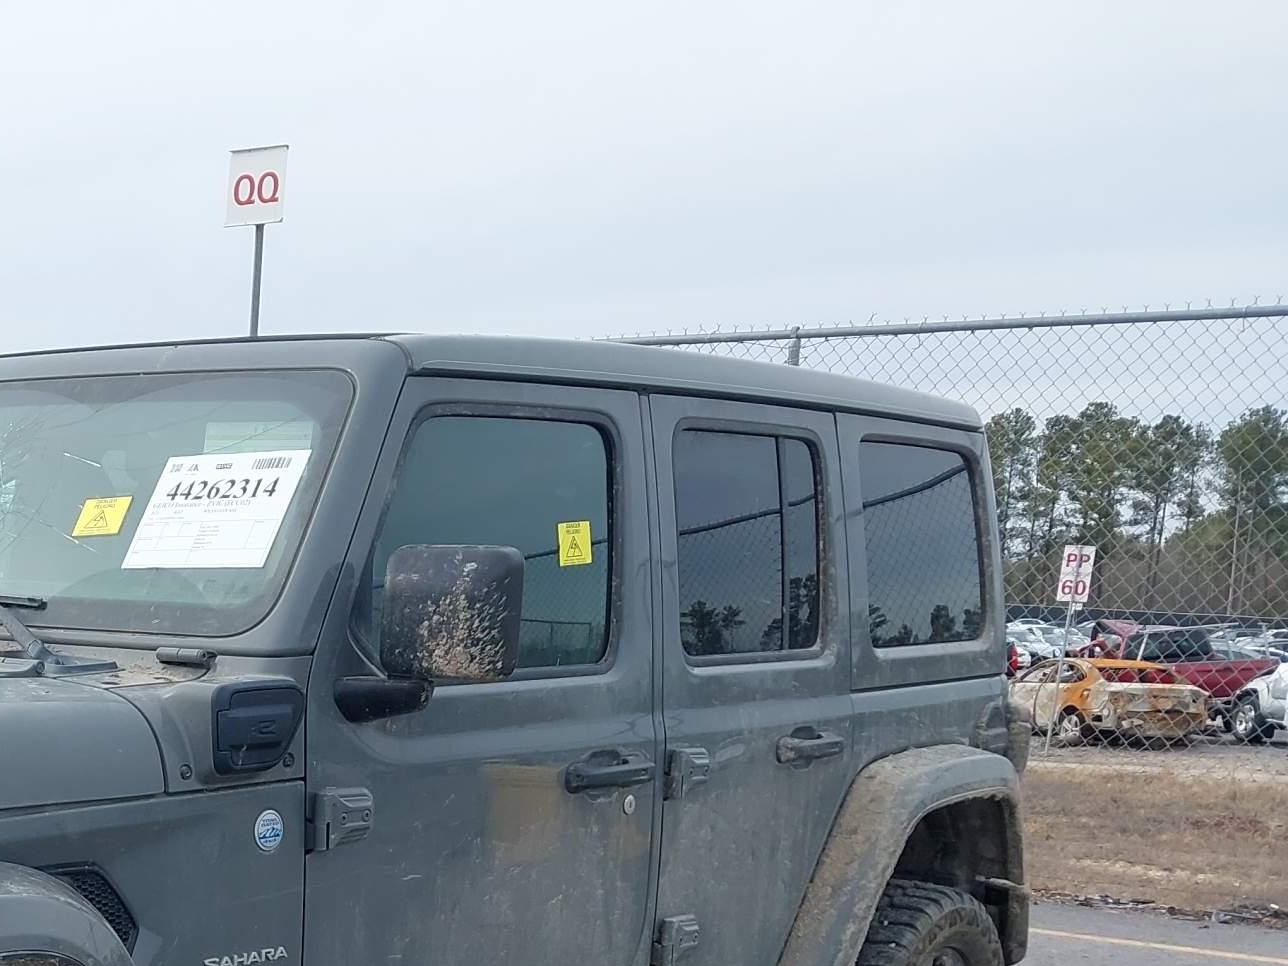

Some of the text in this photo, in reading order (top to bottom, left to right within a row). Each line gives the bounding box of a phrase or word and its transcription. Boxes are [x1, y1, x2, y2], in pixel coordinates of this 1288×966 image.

[233, 171, 280, 206] QQ
[166, 476, 279, 500] 44262314
[1066, 553, 1091, 568] PP
[1062, 579, 1086, 595] 60
